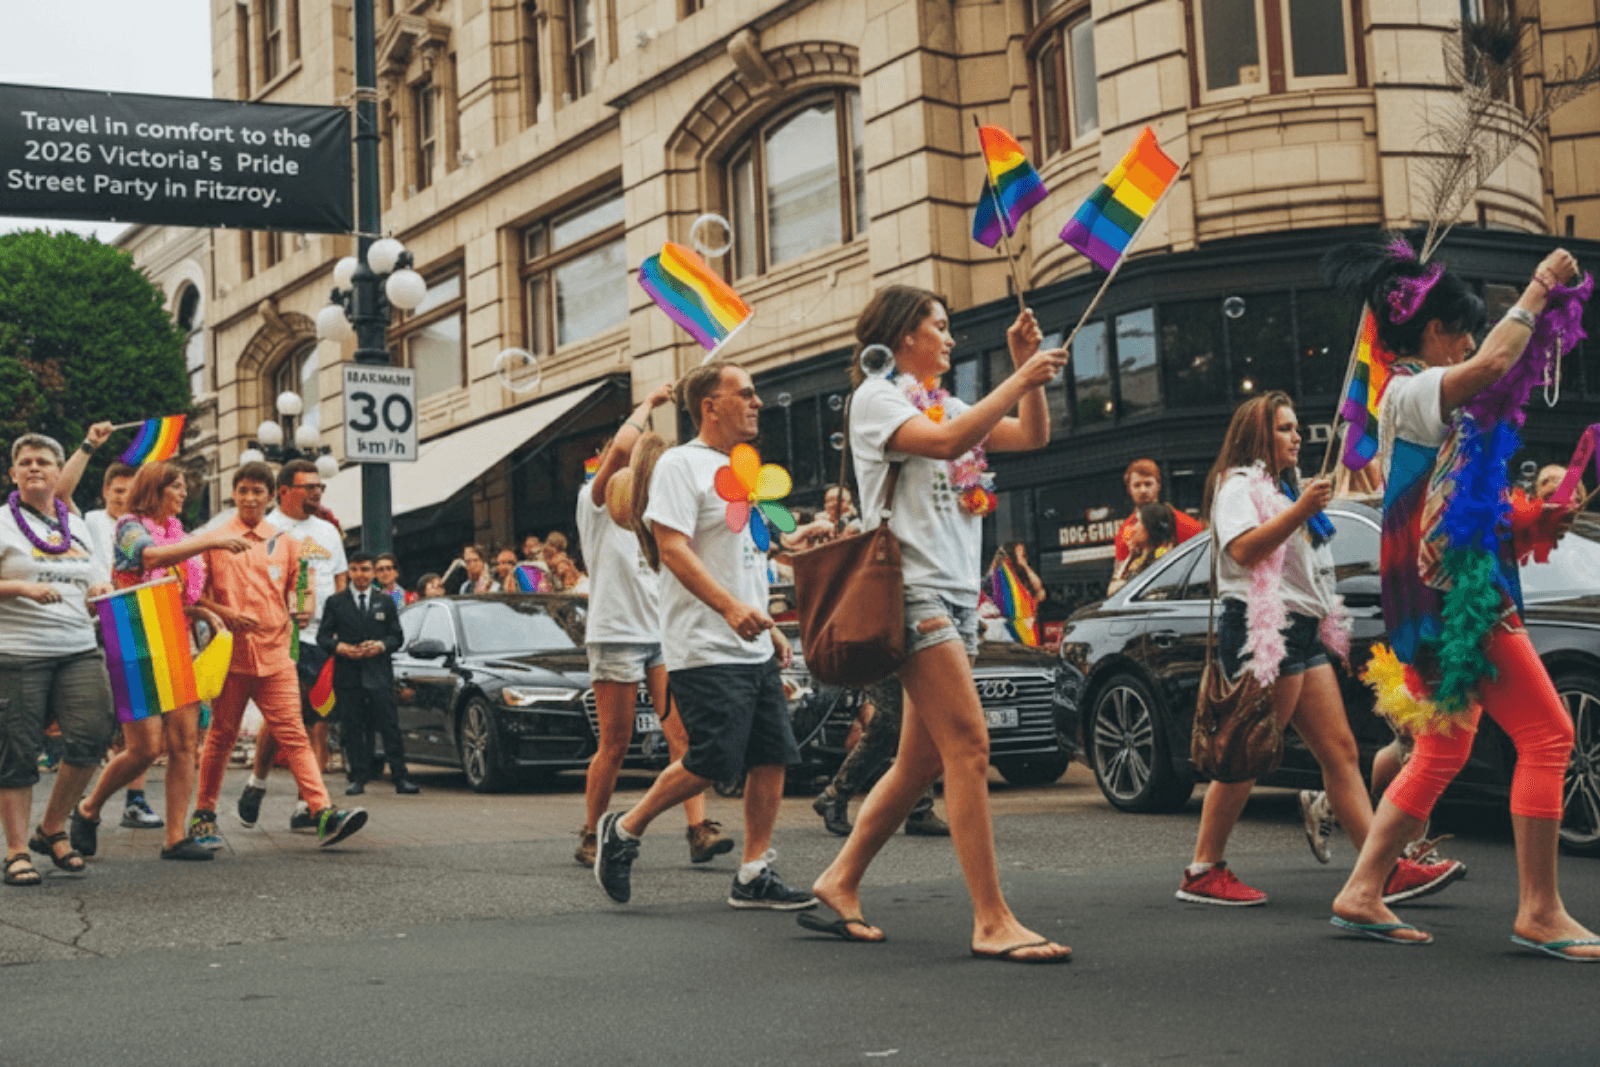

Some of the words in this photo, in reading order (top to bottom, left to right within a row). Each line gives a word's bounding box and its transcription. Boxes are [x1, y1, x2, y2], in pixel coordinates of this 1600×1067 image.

[20, 110, 98, 135] Travel
[105, 115, 128, 136] in
[135, 120, 236, 143] comfort
[240, 127, 267, 146] to
[273, 126, 312, 149] the
[25, 139, 92, 164] 2026
[99, 144, 223, 172] Victoria's
[237, 152, 299, 176] Pride
[7, 168, 86, 193] Street
[94, 174, 158, 201] Party
[165, 177, 187, 198] in
[195, 179, 282, 208] Fitzroy.
[349, 391, 413, 434] 30
[357, 437, 406, 454] km/h
